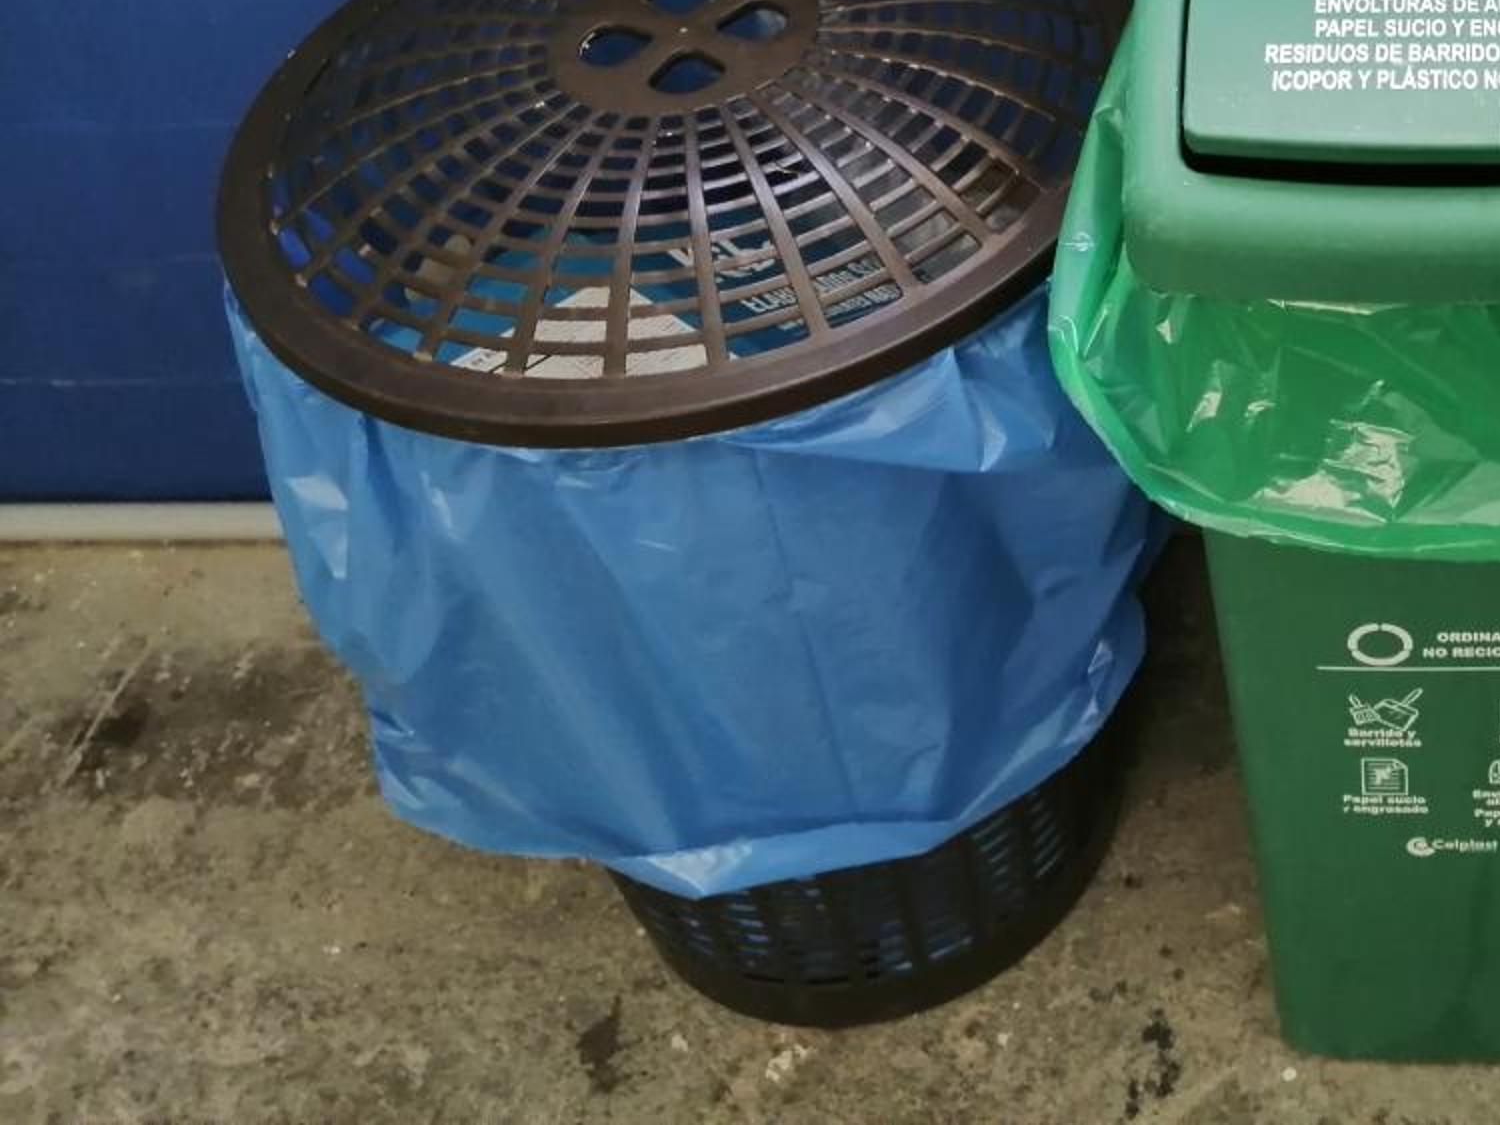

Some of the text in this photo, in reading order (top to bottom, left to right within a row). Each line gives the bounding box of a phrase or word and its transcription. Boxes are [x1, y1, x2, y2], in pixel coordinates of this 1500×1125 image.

[1315, 20, 1379, 37] PAPEL
[1384, 19, 1446, 37] SUCIO
[1452, 20, 1465, 36] Y
[1265, 43, 1369, 64] RESIDUOS
[1375, 44, 1402, 63] DE
[1272, 70, 1353, 92] ICOPOR
[1358, 71, 1372, 89] Y
[1377, 65, 1479, 90] PLÁSTICO
[1423, 647, 1448, 658] NO
[1407, 730, 1417, 740] y
